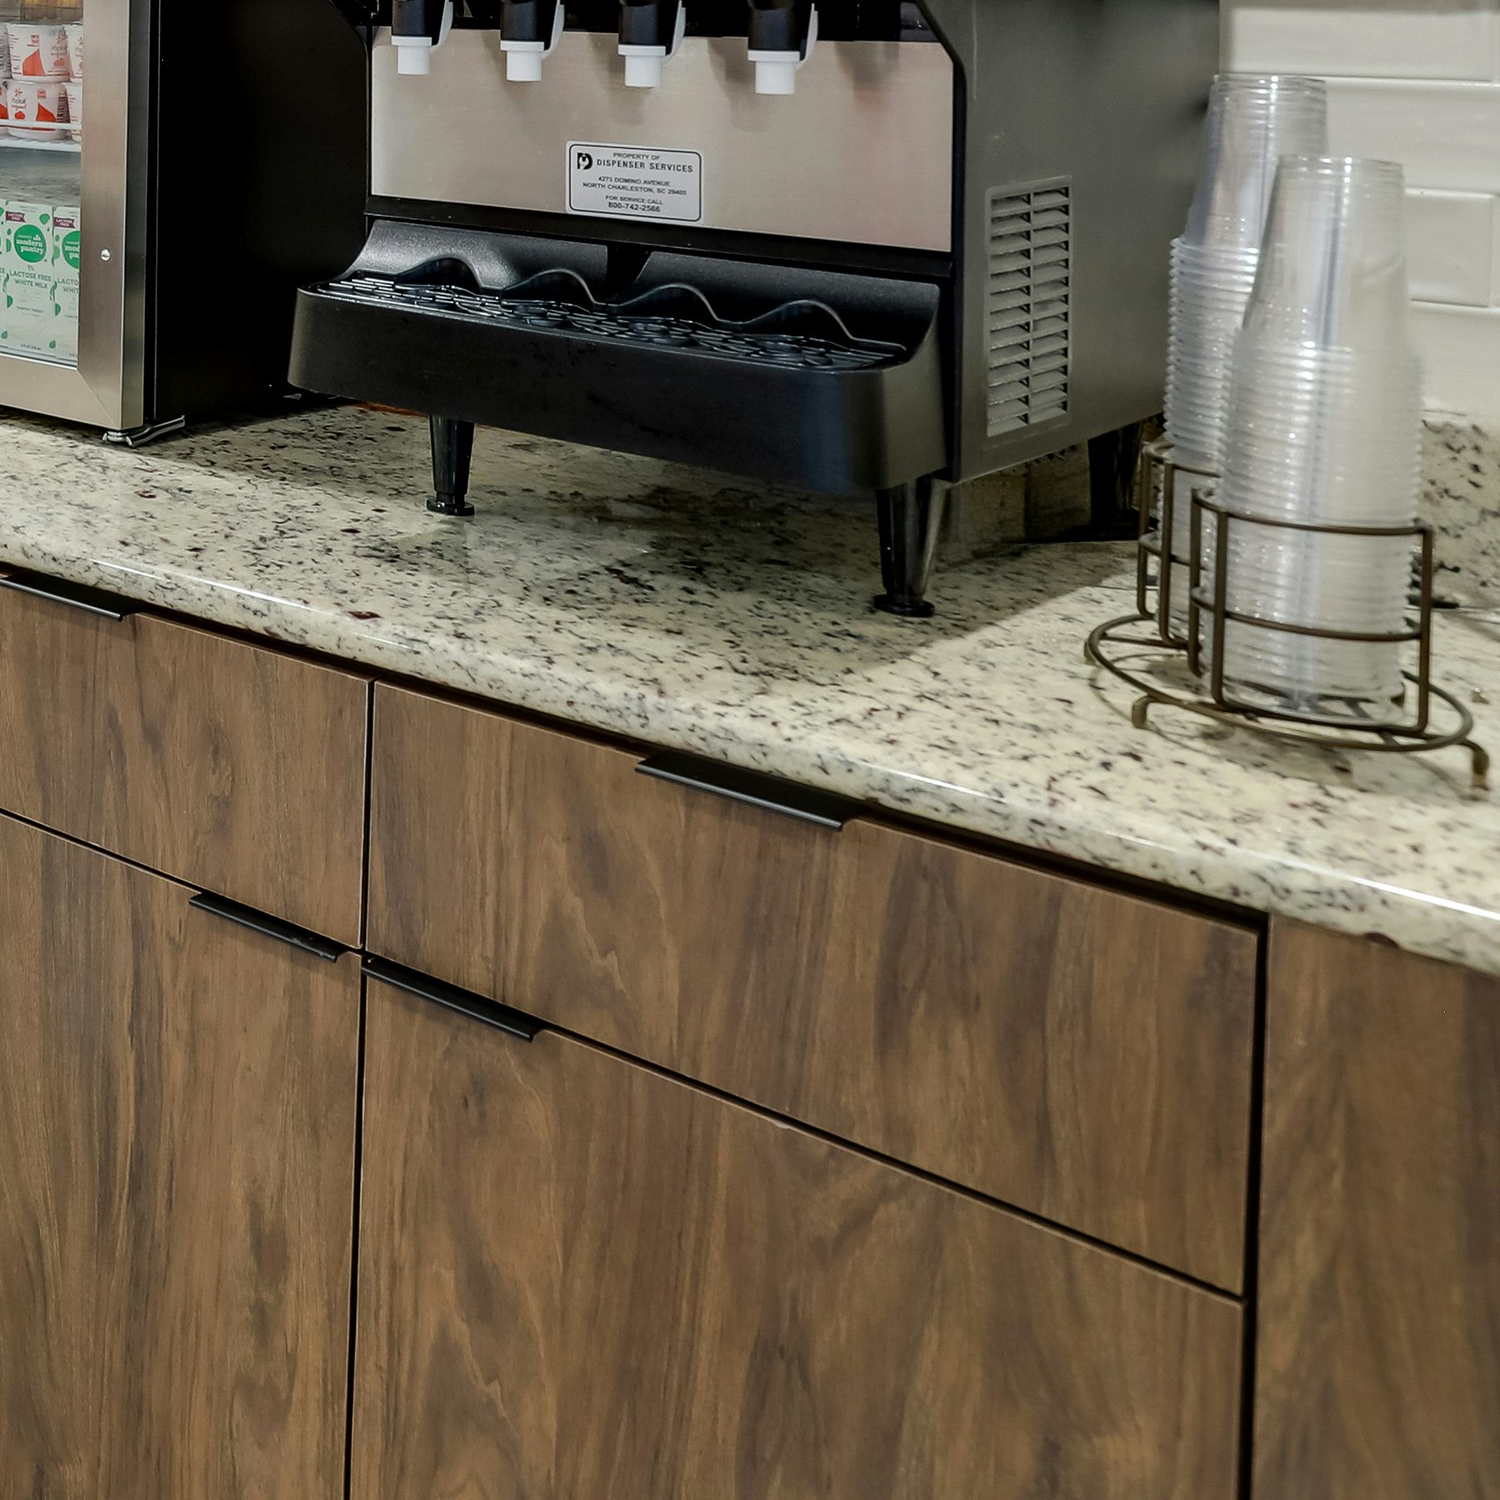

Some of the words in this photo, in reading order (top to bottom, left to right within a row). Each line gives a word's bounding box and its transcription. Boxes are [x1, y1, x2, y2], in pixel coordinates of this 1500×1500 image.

[613, 152, 649, 160] PROPERTY
[596, 158, 645, 169] DISPENSER
[650, 162, 693, 173] SERVICES
[614, 177, 642, 185] DOMINO
[643, 179, 670, 187] AVENUE
[16, 239, 43, 248] modern
[20, 246, 44, 255] pantry
[9, 270, 37, 280] LACTOSE
[38, 274, 51, 282] FREE
[14, 279, 34, 287] WHITE
[35, 281, 48, 289] MILK
[58, 277, 79, 286] LACTO
